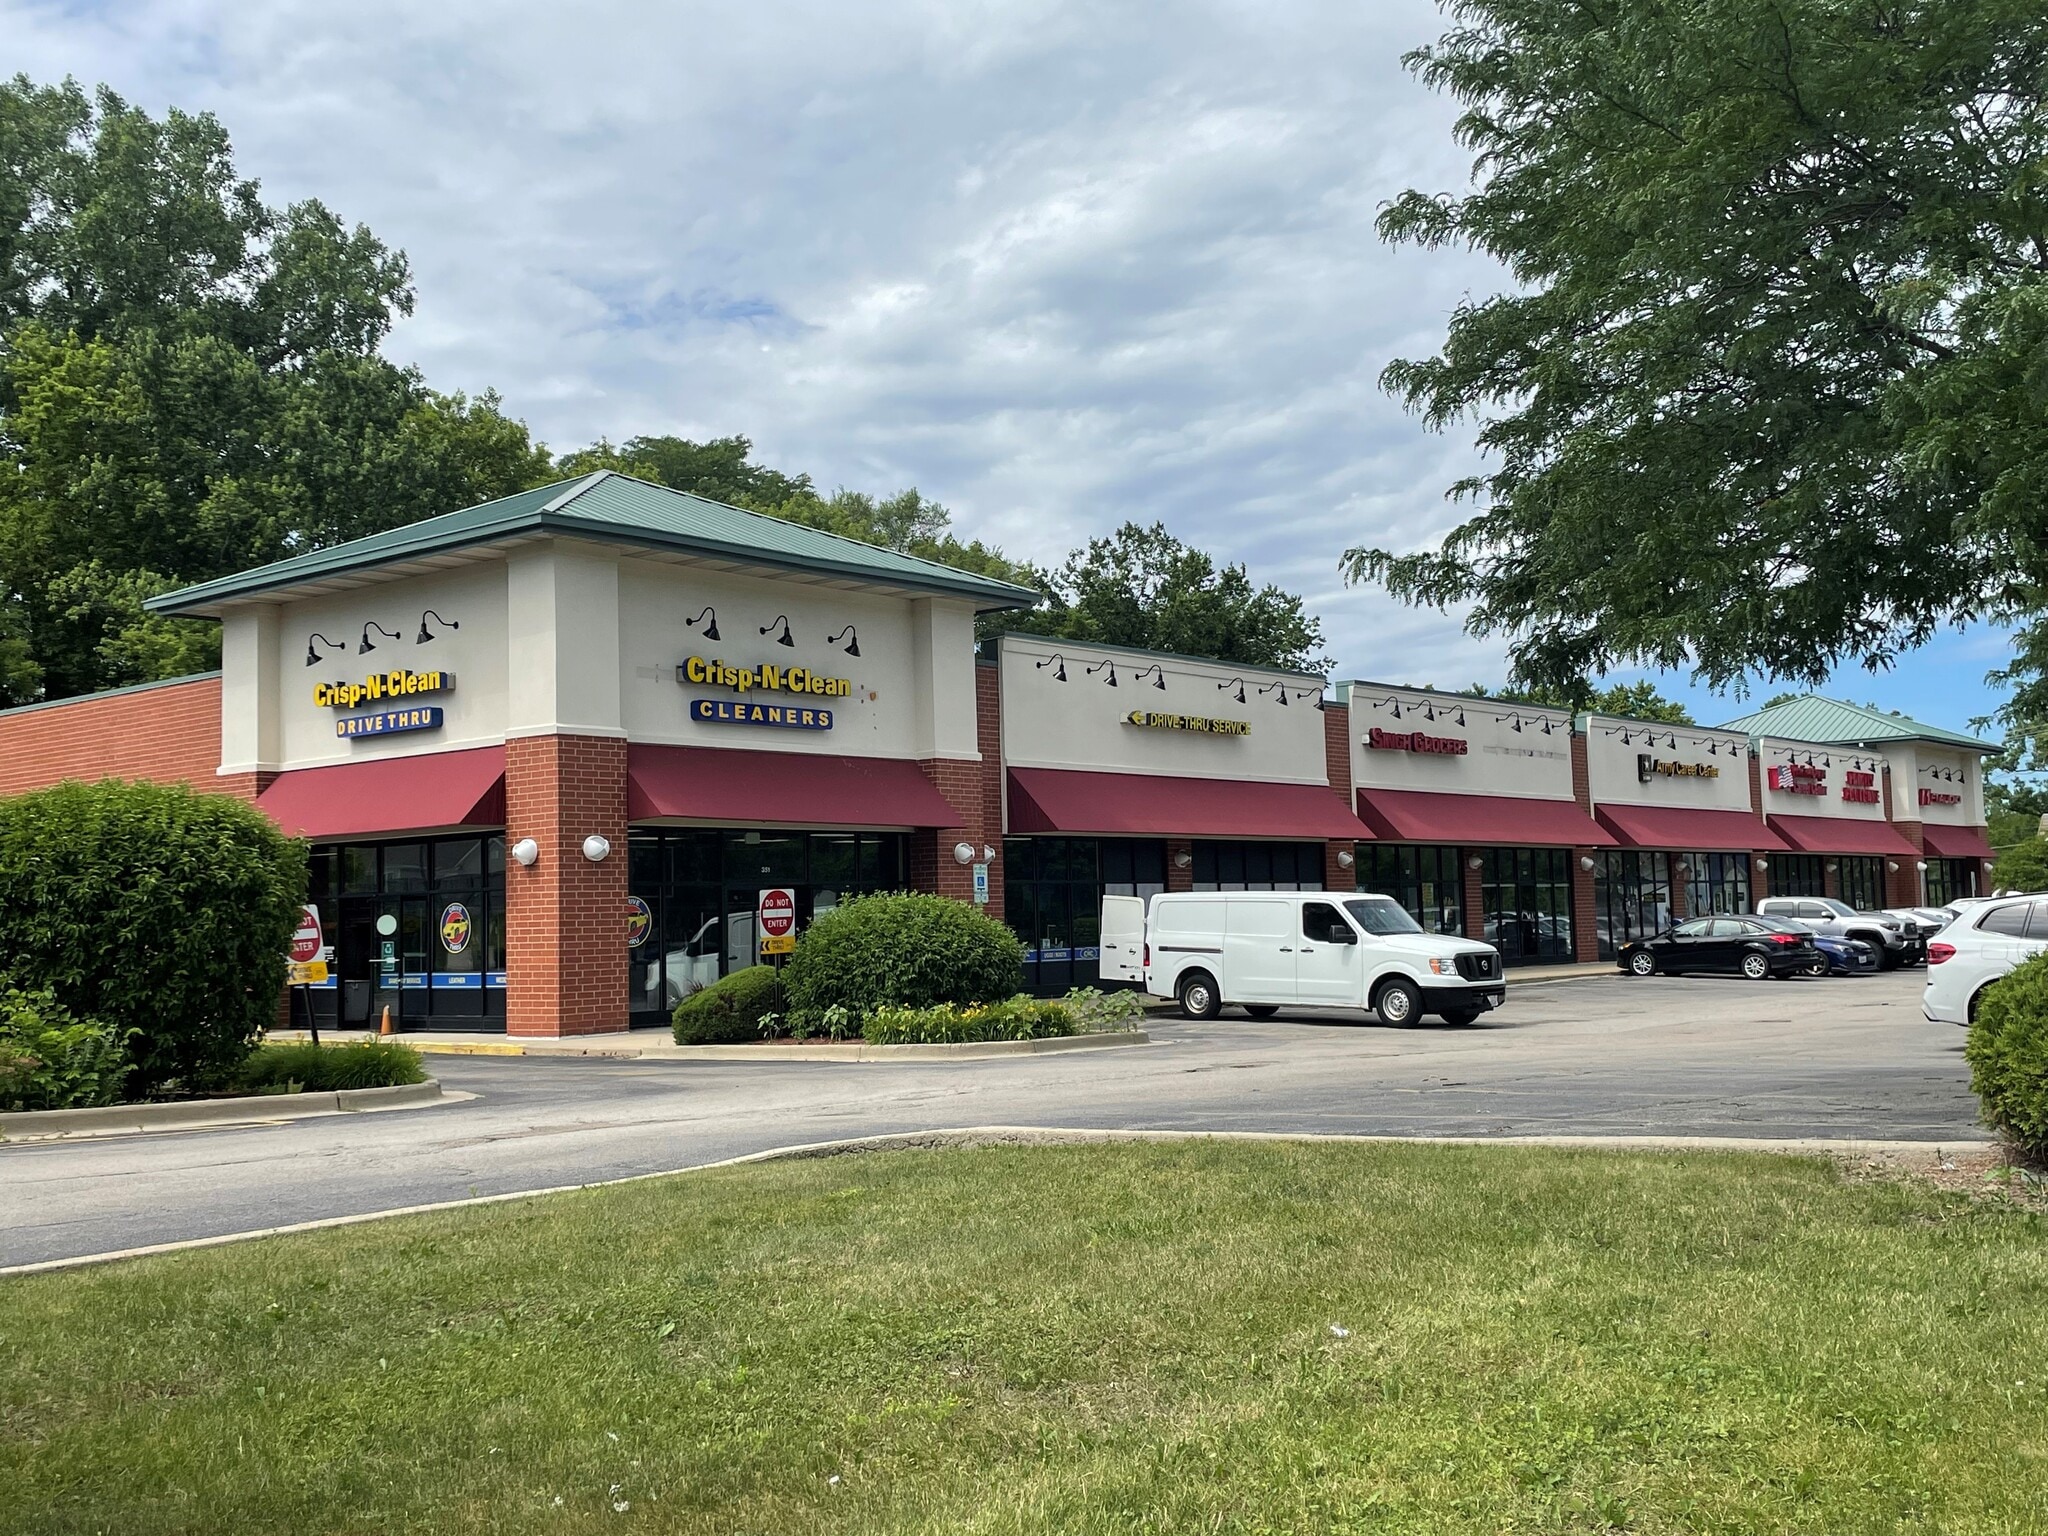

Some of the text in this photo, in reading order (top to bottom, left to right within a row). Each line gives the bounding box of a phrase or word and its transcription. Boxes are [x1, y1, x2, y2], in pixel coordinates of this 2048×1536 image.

[683, 656, 851, 696] Crisp-N-Clean
[313, 669, 446, 708] Crisp-N-Clean
[337, 709, 431, 735] DRIVE THRU
[699, 702, 830, 727] CLEANERS
[1146, 713, 1251, 735] DRIVE-THRU SERVICE
[1653, 759, 1675, 777] Army
[765, 898, 789, 907] DO NOT
[767, 919, 788, 928] ENTER
